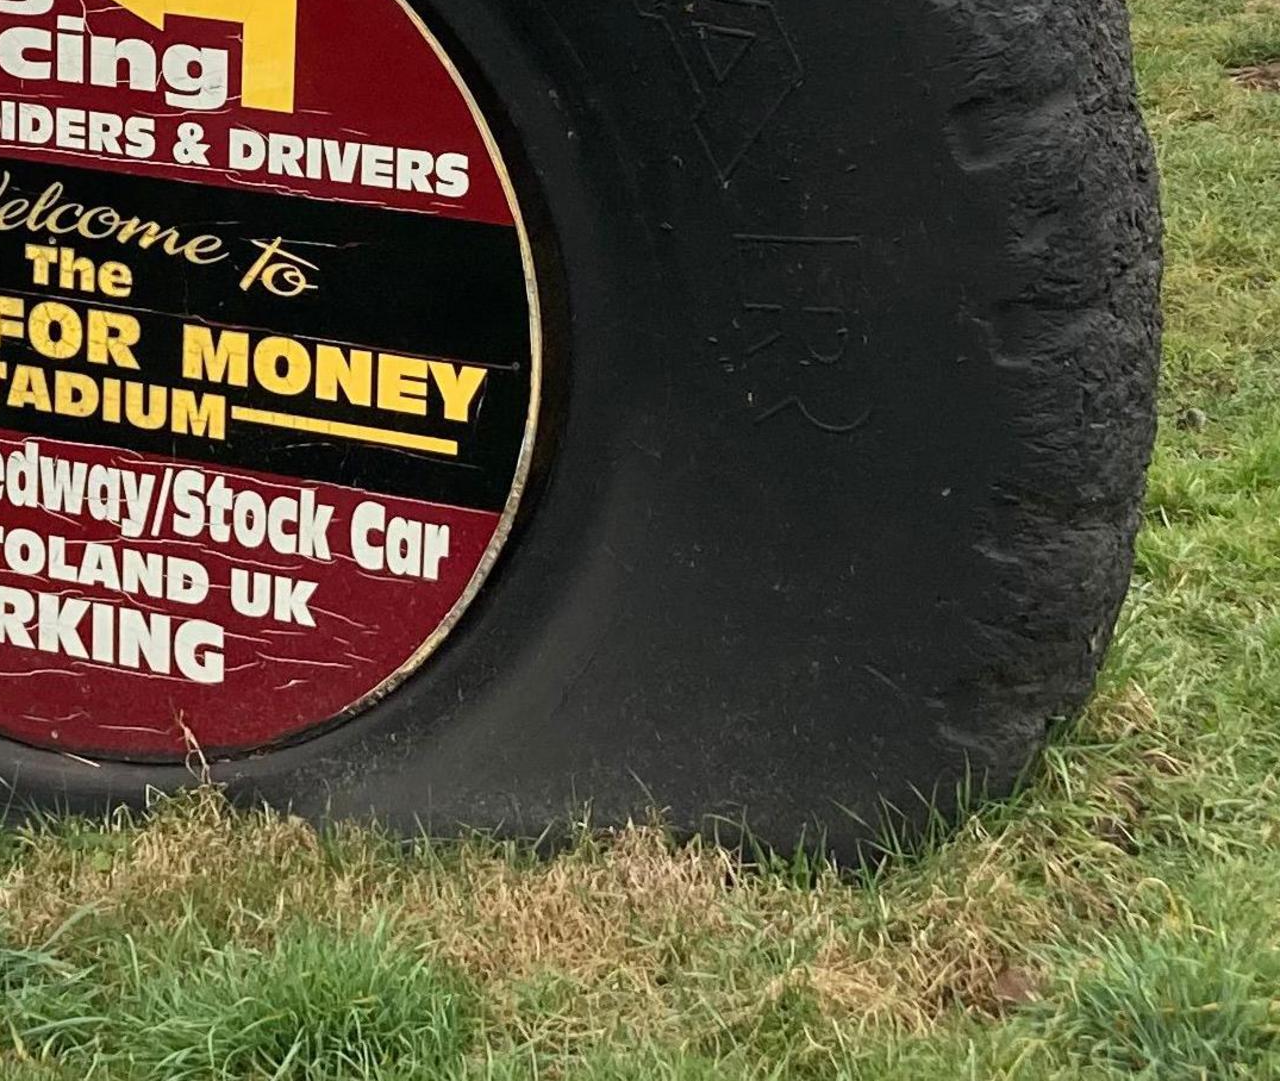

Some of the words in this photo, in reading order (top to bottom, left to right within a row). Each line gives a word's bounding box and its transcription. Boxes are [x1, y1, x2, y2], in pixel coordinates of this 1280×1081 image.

[172, 122, 211, 166] &
[228, 127, 470, 198] DRIVERS
[24, 243, 133, 297] The
[182, 324, 488, 423] MONEY
[350, 500, 451, 581] Car
[230, 567, 318, 628] UK
